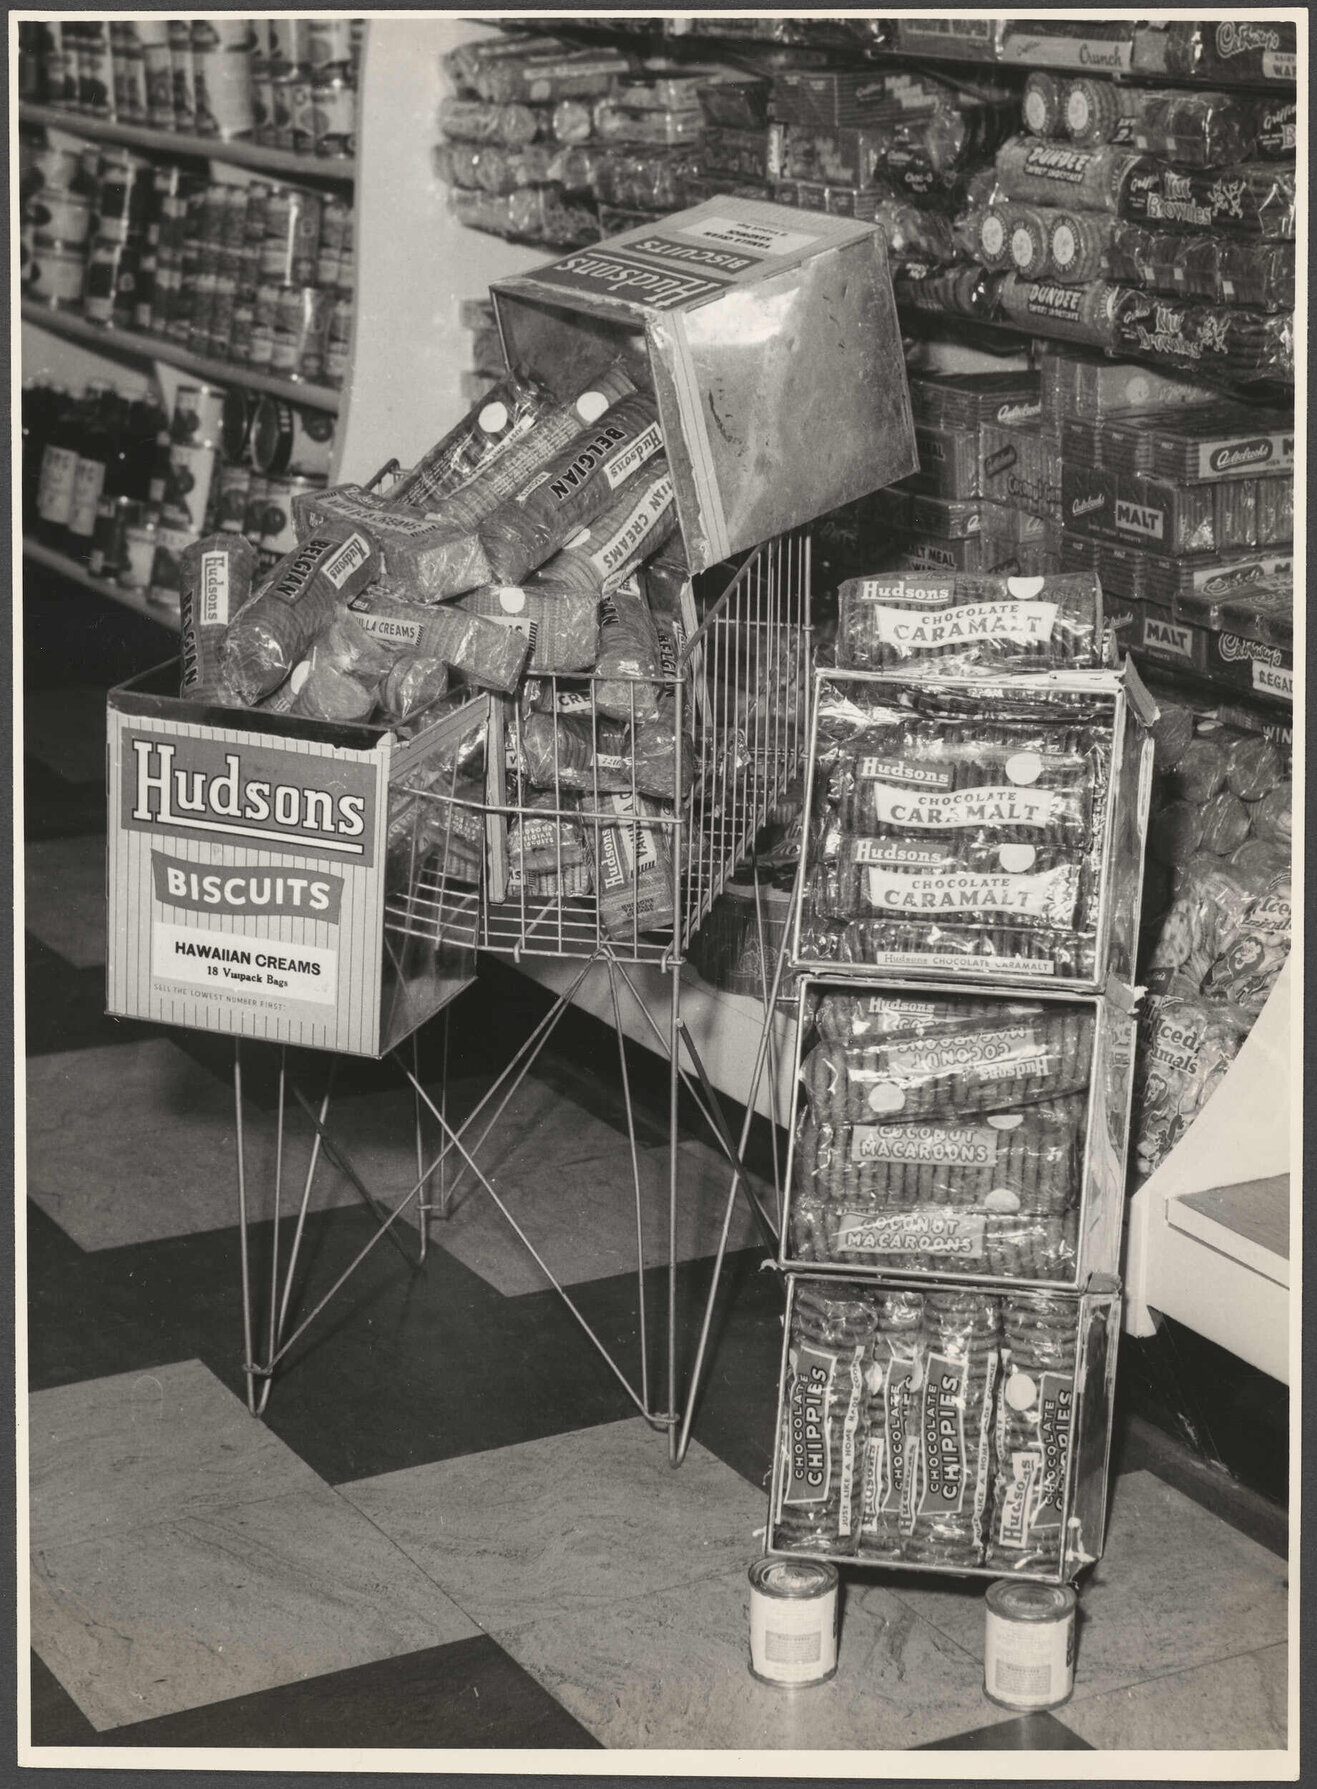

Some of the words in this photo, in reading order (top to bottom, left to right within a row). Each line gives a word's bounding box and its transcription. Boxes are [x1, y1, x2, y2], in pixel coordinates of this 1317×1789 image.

[1079, 43, 1122, 67] Crunch
[1028, 147, 1092, 171] DUNDEE
[635, 240, 749, 269] BISCUITS
[554, 257, 723, 308] Hudsons
[1029, 284, 1083, 310] DUNDEE
[550, 427, 628, 500] BELGIAN
[610, 429, 669, 480] Hudsons
[1117, 504, 1159, 530] MALT
[603, 513, 649, 569] CREAMS
[276, 539, 333, 599] BELGIAN
[328, 538, 368, 580] Hudsons
[205, 556, 225, 621] Hudsons
[861, 581, 950, 600] Hudsons
[921, 604, 1020, 625] CHOCOLATE
[182, 591, 199, 688] BELGIAN
[378, 622, 415, 639] CREAMS
[893, 616, 1043, 642] CARAMALT
[1147, 622, 1188, 649] MALT
[861, 757, 949, 784] Hudsons
[132, 738, 366, 838] Hudsons
[918, 791, 1017, 806] CHOCOLATE
[890, 804, 1040, 824] CARAMALT
[601, 828, 624, 890] Hudsons
[855, 840, 942, 862] Hudsons
[166, 866, 331, 911] BISCUITS
[911, 878, 1011, 890] CHOCOLATE
[884, 889, 1034, 909] CARAMALT
[174, 940, 252, 966] HAWAIIAN
[254, 952, 321, 976] CREAMS
[884, 953, 928, 964] Hudsons
[932, 956, 990, 968] CHOCOLATE
[206, 966, 219, 976] 18
[266, 974, 288, 989] Bags
[153, 983, 171, 992] SELL
[173, 986, 188, 995] THE
[189, 988, 223, 1001] LOWEST
[226, 994, 258, 1006] NUMBER
[869, 997, 936, 1015] Hudsons
[1156, 1018, 1198, 1051] Iced
[911, 1042, 1011, 1071] COCONUT
[978, 1056, 1051, 1081] Hudsons
[878, 1125, 977, 1144] COCONUT
[860, 1141, 989, 1163] MACAROONS
[861, 1213, 960, 1236] COCONUT
[845, 1231, 973, 1252] MACAROONS
[848, 1396, 860, 1422] MADE
[793, 1374, 810, 1481] CHOCOLATE
[806, 1366, 829, 1488] CHIPPIES
[890, 1384, 904, 1491] CHOCOLATE
[927, 1382, 940, 1494] CHOCOLATE
[940, 1374, 960, 1500] CHIPPIES
[844, 1428, 853, 1457] HOME
[1041, 1399, 1056, 1504] CHOCOLATE
[845, 1462, 851, 1471] A
[980, 1441, 988, 1471] HOME
[843, 1477, 851, 1498] LIKE
[980, 1476, 986, 1486] A
[1002, 1458, 1034, 1544] Hudsons
[841, 1504, 849, 1527] JUST
